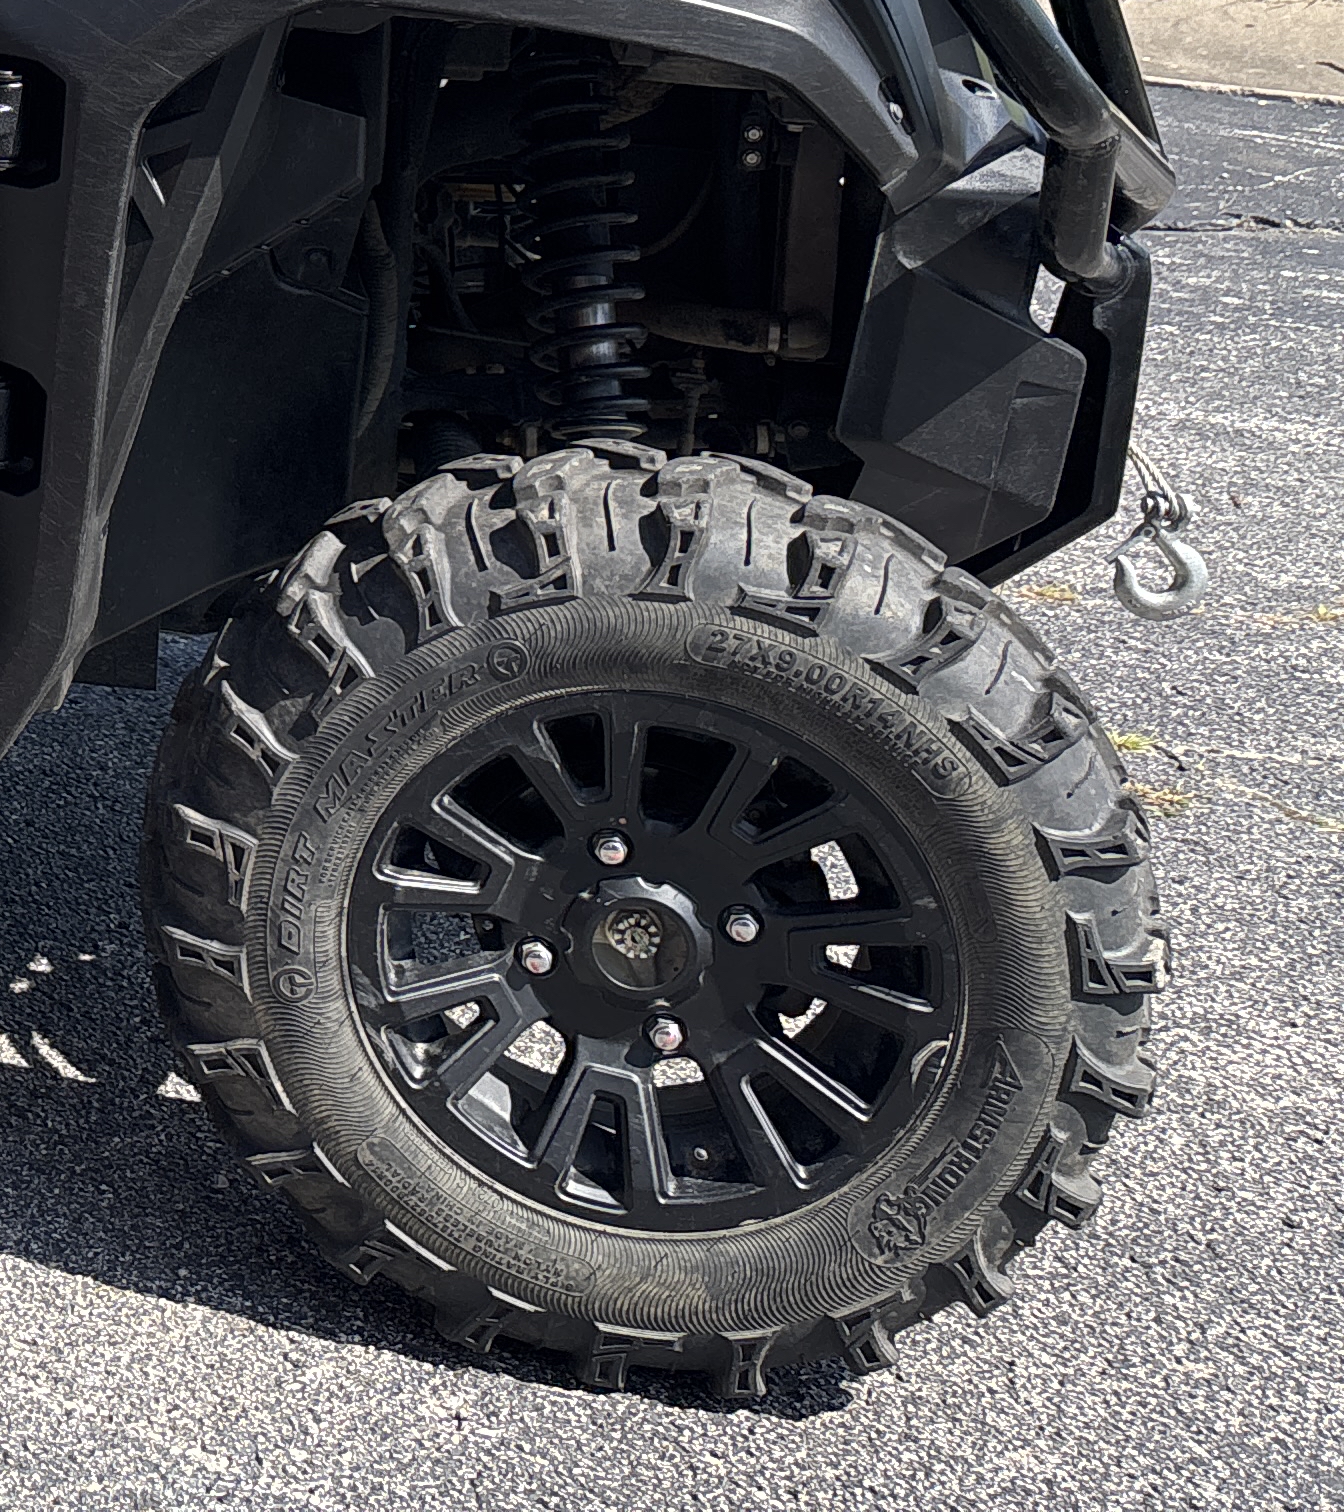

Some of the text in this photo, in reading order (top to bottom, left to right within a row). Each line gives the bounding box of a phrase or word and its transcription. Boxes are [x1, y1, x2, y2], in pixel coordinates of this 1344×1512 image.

[279, 831, 322, 955] DIRT
[314, 662, 482, 824] MASTER
[906, 1034, 1024, 1216] ARMSTRONG
